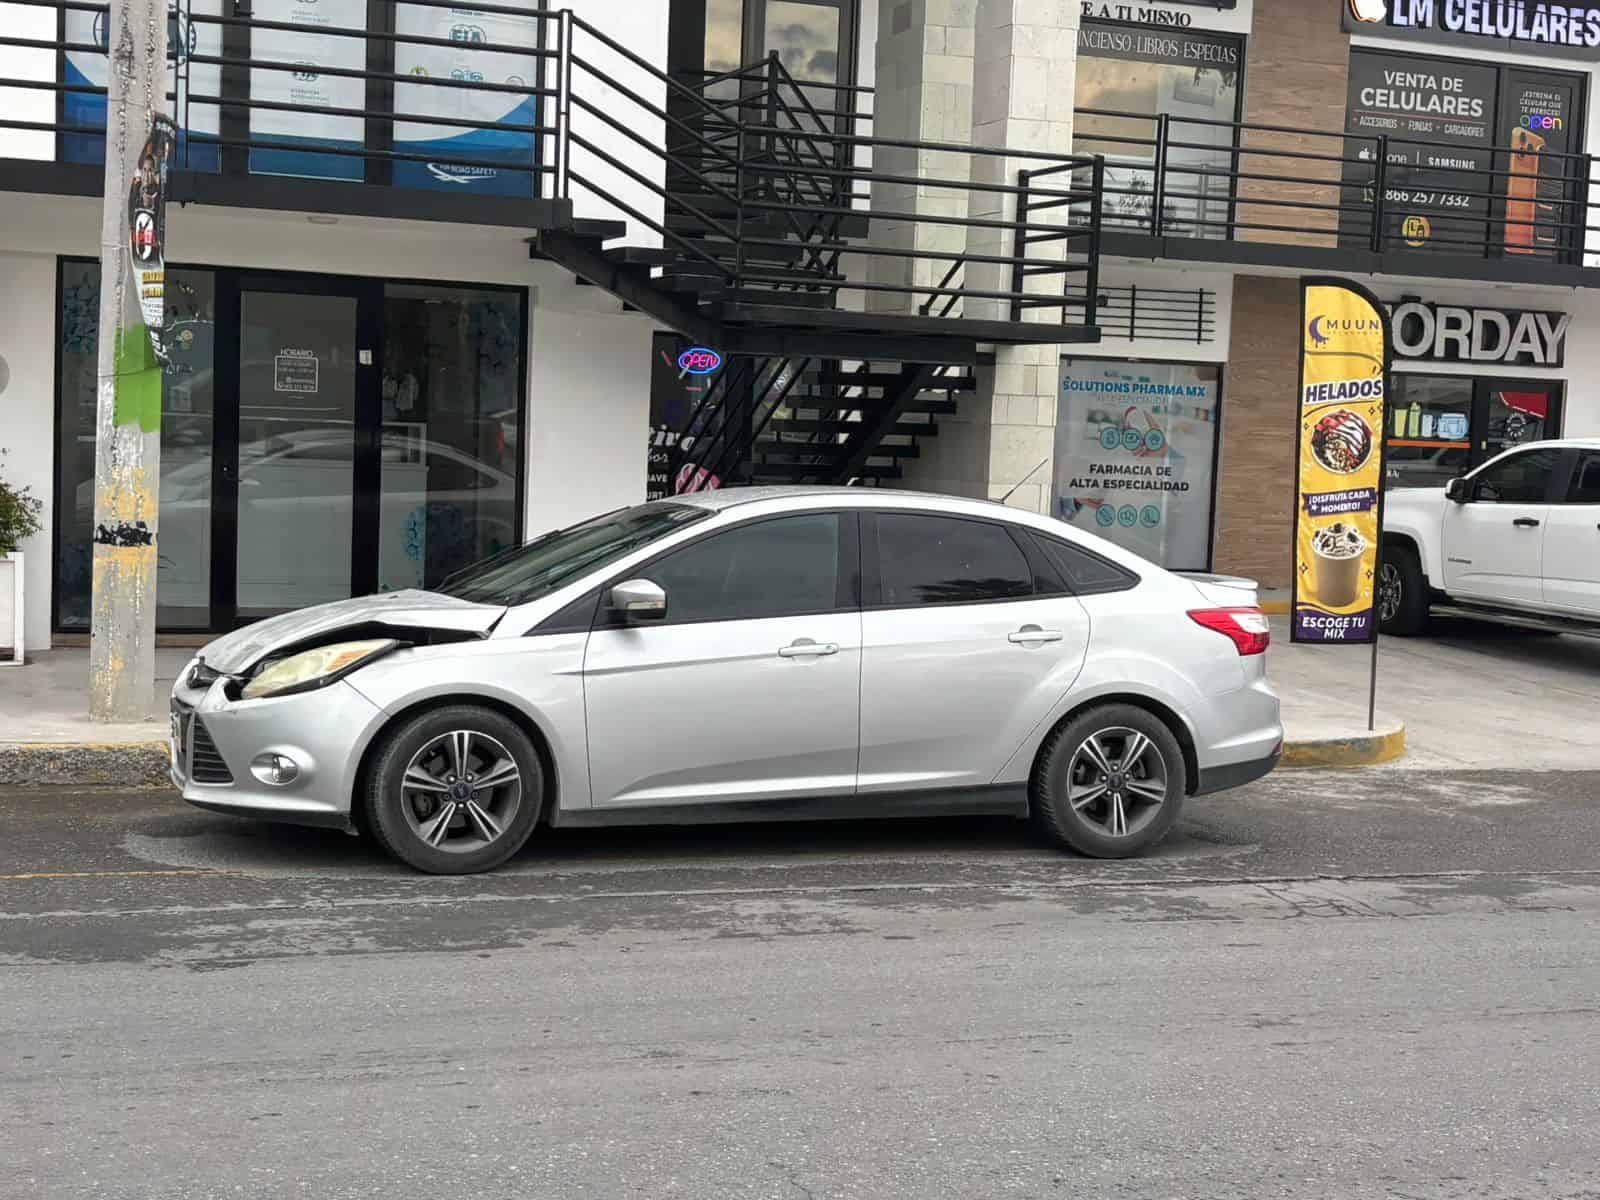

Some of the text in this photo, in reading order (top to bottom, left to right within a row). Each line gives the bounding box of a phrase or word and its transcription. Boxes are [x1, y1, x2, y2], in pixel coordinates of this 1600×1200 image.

[1080, 1, 1191, 26] E A TI MISMO
[1393, 0, 1600, 47] LM CELULARES
[1078, 31, 1237, 64] INCIENSO LIBROS ESPECIAS
[1384, 70, 1464, 92] VENTA DE
[1360, 88, 1483, 117] CELULARES
[1520, 115, 1562, 130] open
[1327, 319, 1379, 330] MUUN
[1388, 302, 1574, 364] ORDAY
[682, 353, 718, 369] OPEN
[1063, 380, 1206, 397] SOLUTIONS PHARMA MX
[1305, 380, 1382, 402] HELADOS
[1089, 464, 1172, 477] FARMACIA DE
[1069, 478, 1189, 492] ALTA ESPECIALIDAD
[1348, 490, 1370, 500] CADA
[1302, 616, 1366, 628] ESCOGE TU
[1324, 628, 1345, 639] MIX
